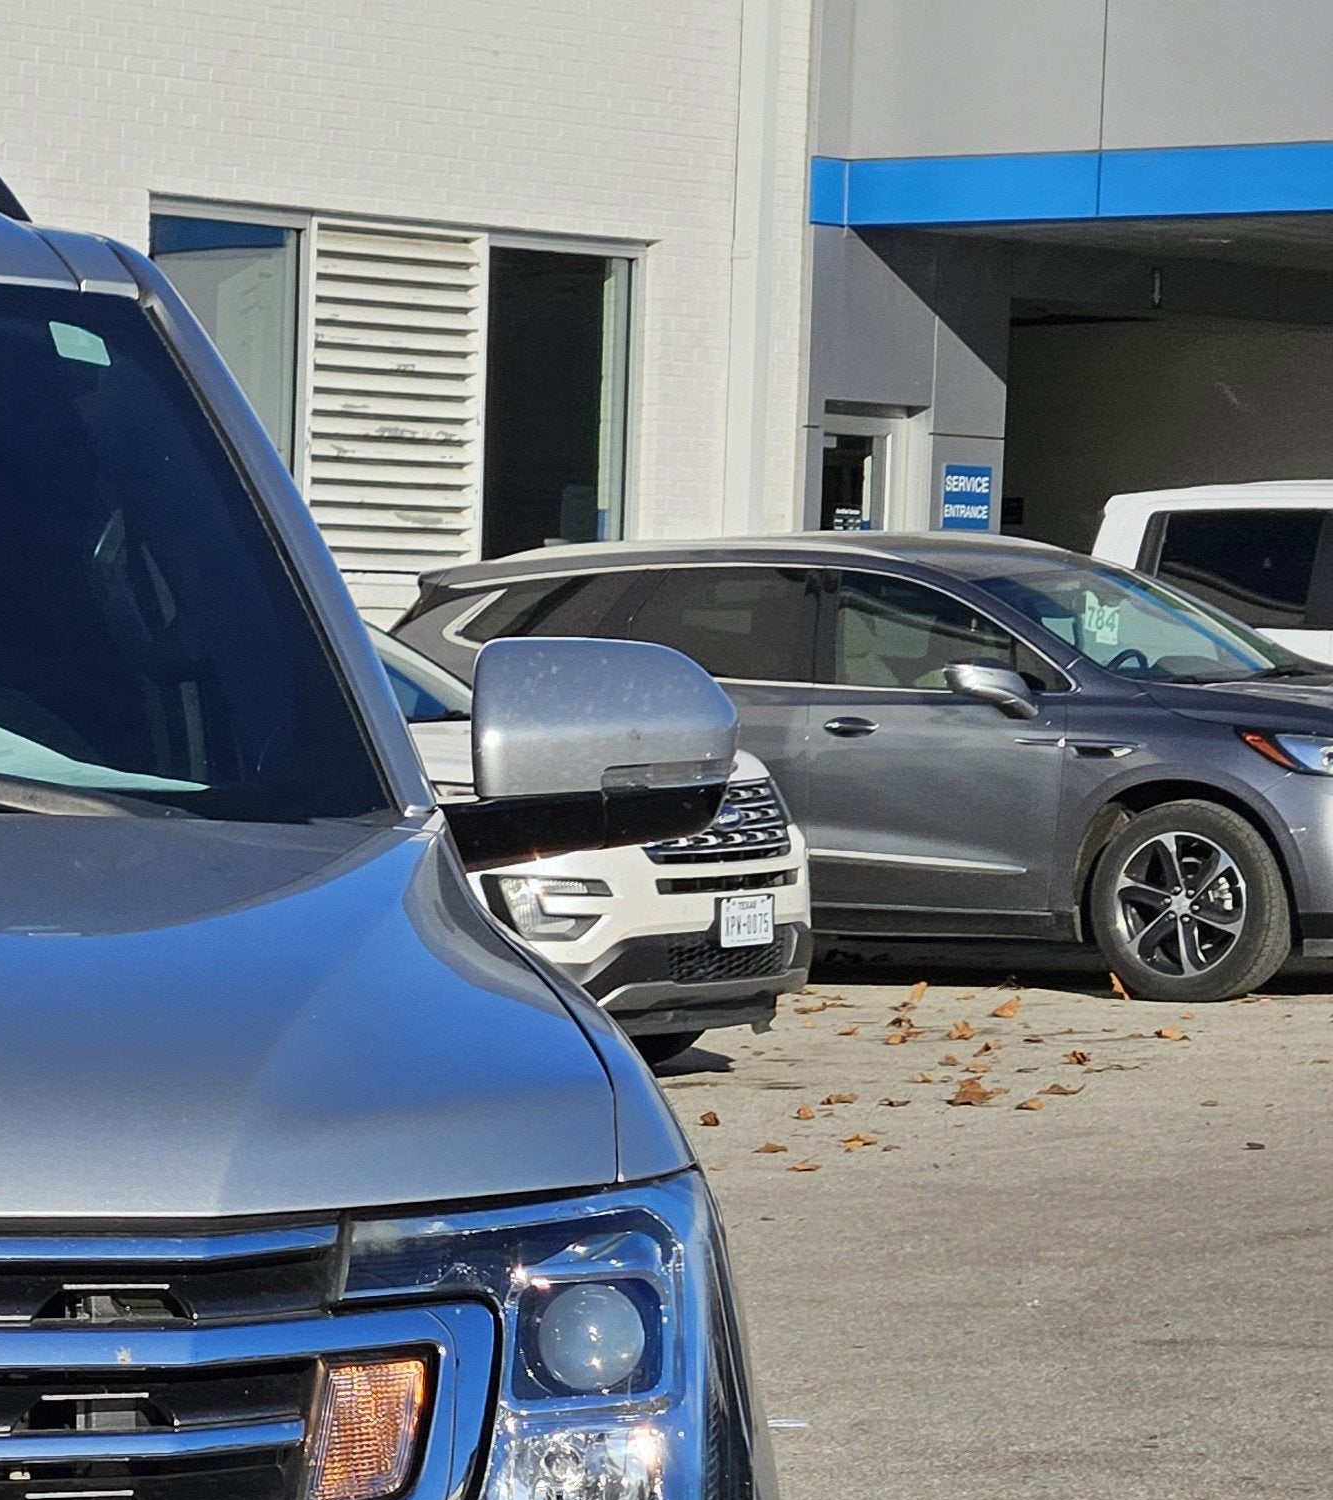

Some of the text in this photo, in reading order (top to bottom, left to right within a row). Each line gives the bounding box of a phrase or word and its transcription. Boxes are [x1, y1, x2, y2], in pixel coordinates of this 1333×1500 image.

[945, 475, 990, 493] SERVICE
[944, 504, 989, 519] ENTRANCE
[1088, 605, 1119, 632] 784
